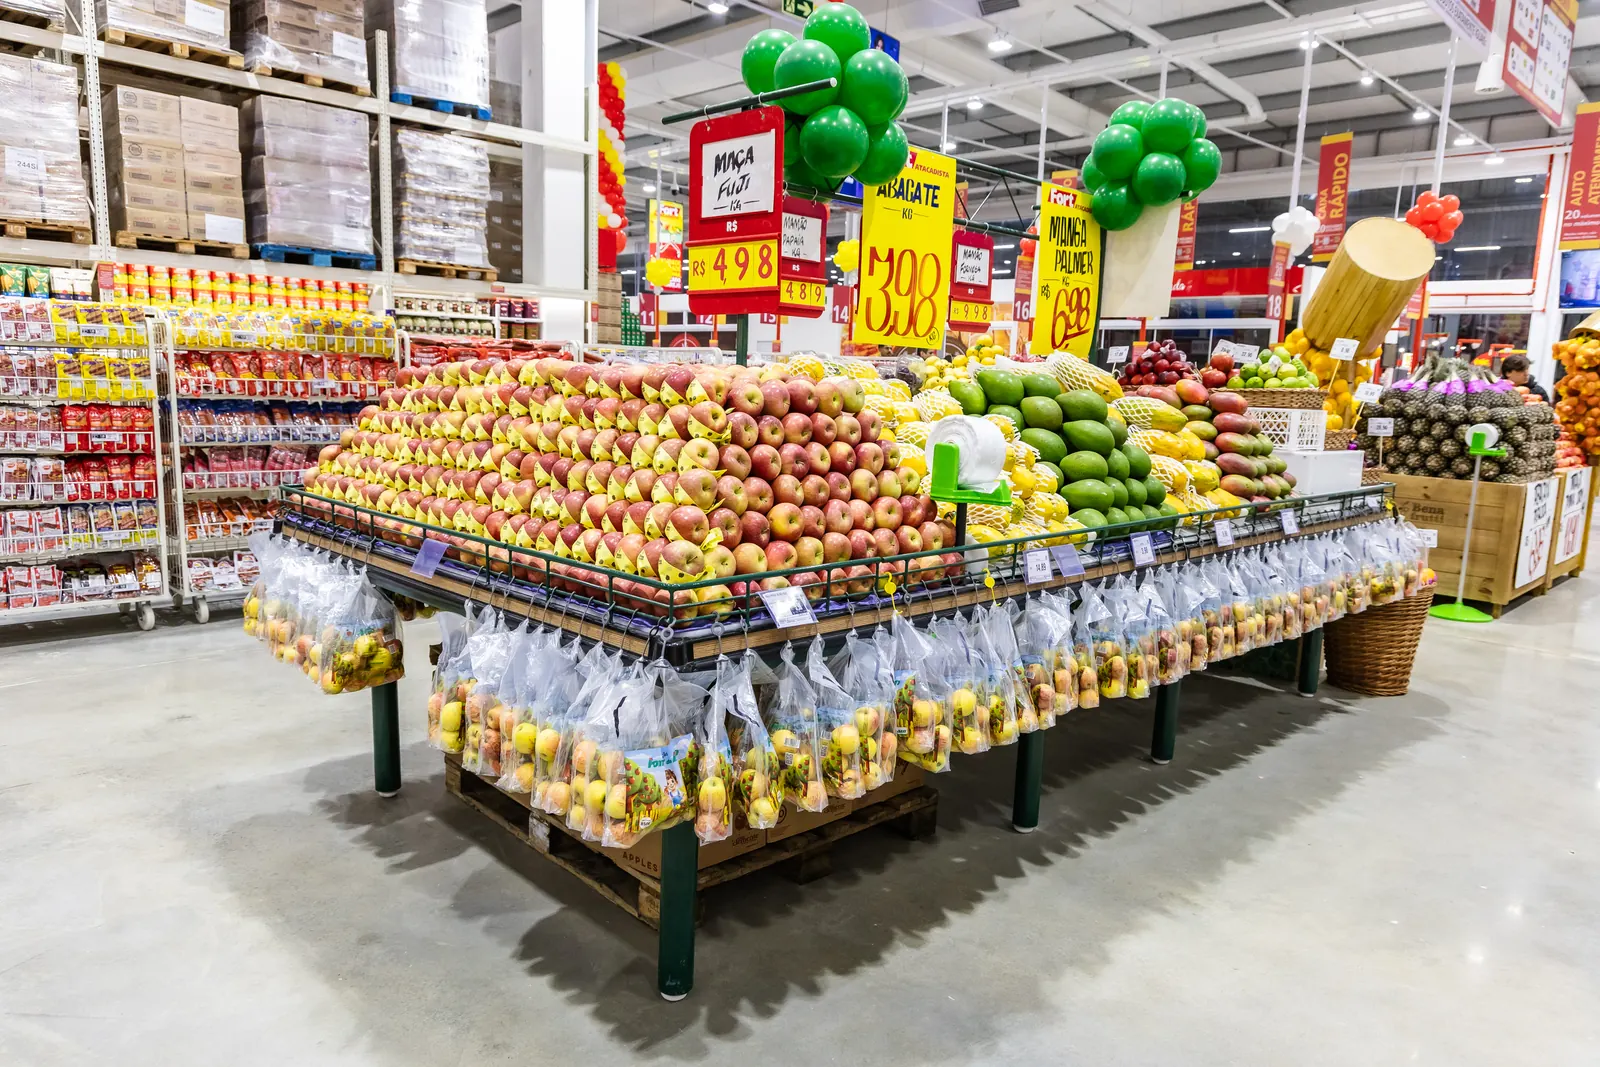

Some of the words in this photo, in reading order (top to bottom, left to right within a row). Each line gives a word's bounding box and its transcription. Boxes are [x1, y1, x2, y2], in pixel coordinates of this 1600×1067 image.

[714, 146, 754, 178] MAÇA
[914, 163, 950, 179] ATACADISTA
[717, 172, 752, 202] FUJI
[1329, 152, 1349, 219] RÁPIDO
[1570, 170, 1587, 206] AUTO
[1050, 187, 1075, 208] Fort
[1318, 187, 1329, 220] CAIXA
[1564, 209, 1581, 220] 20
[726, 219, 738, 232] R$
[1049, 216, 1088, 249] MANGA
[692, 259, 706, 277] R$
[792, 264, 801, 272] R$
[1054, 249, 1095, 276] PALMER
[833, 304, 850, 323] 14
[1014, 300, 1030, 321] 16
[1268, 294, 1283, 318] 18
[640, 310, 656, 325] 11
[1411, 502, 1444, 515] Bena
[622, 851, 658, 872] APPLES
